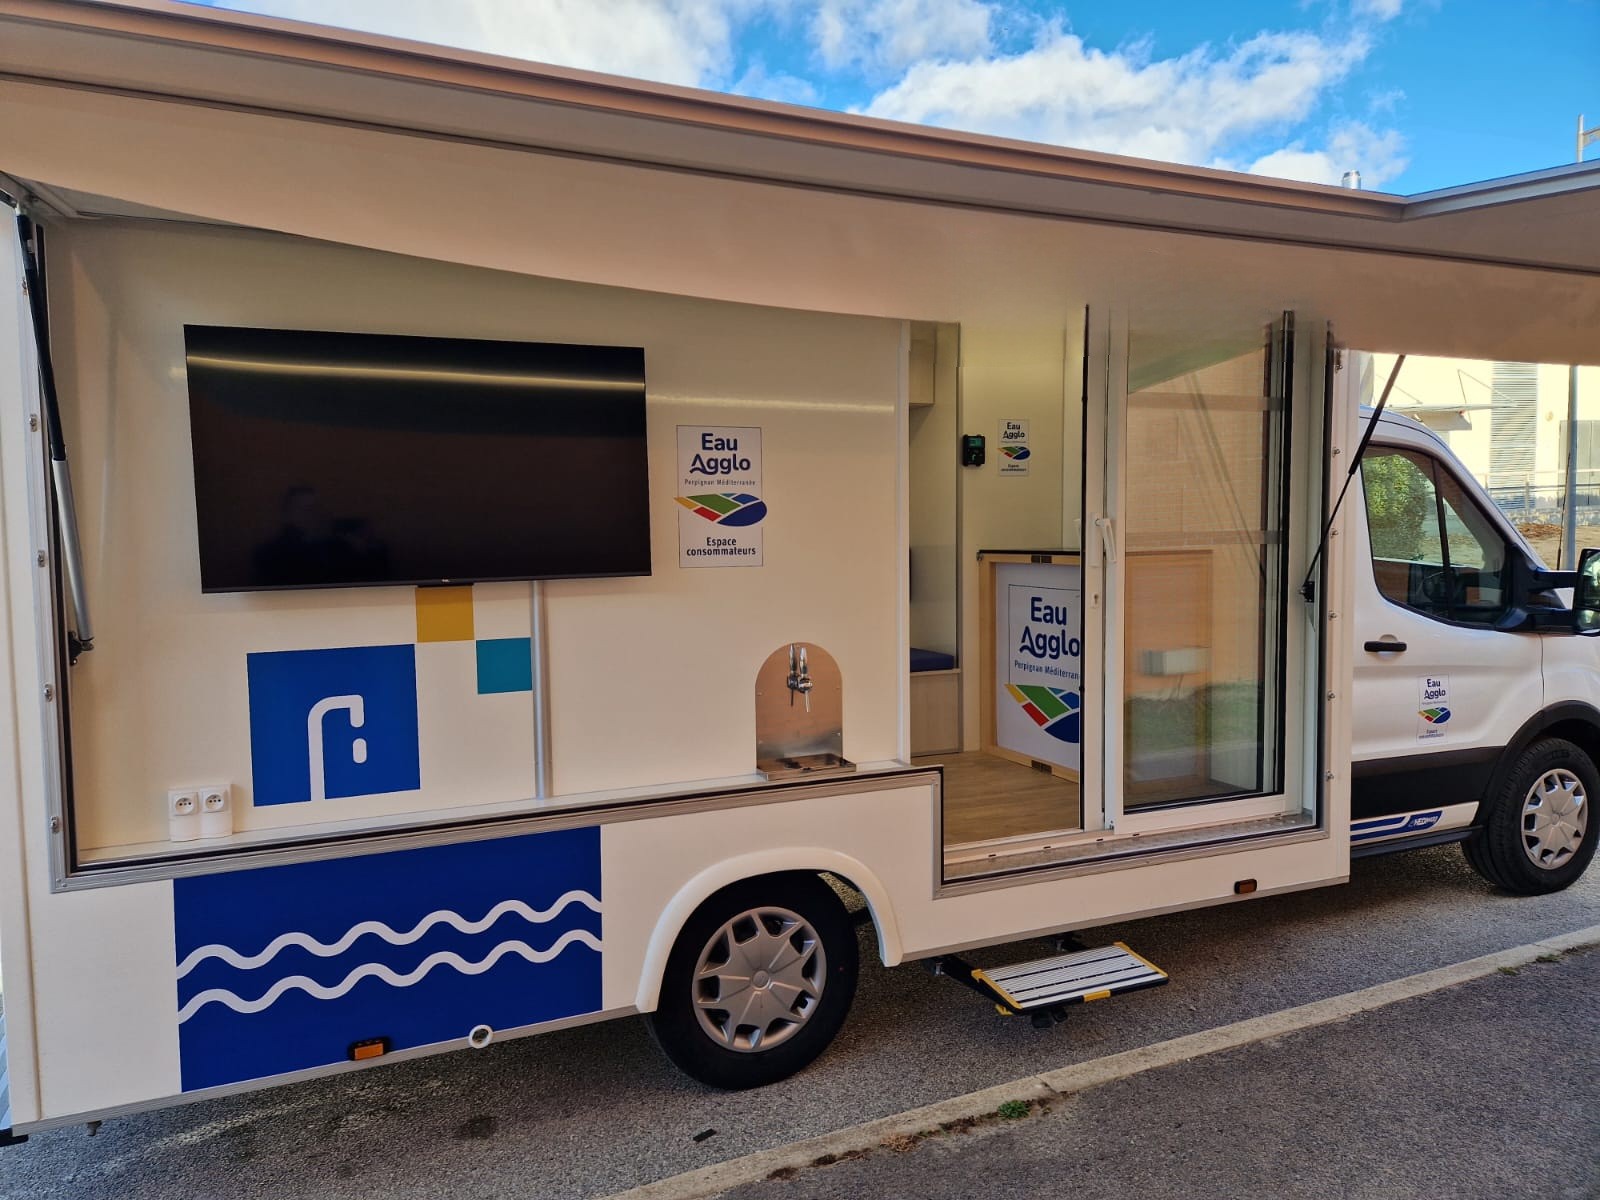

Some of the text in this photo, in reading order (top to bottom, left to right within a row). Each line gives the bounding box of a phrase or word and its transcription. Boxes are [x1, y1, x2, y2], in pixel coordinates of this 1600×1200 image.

[1007, 422, 1021, 430] Eau
[701, 432, 738, 451] Eau
[1003, 431, 1025, 439] Agglo
[689, 453, 751, 475] Agglo
[706, 536, 737, 548] Espace
[686, 546, 756, 556] consommateurs
[1030, 596, 1067, 626] Eau
[1019, 625, 1080, 660] Agglo
[1014, 659, 1080, 680] Perpignan Méditerran
[1426, 678, 1441, 688] Eau
[1423, 687, 1447, 700] Agglo
